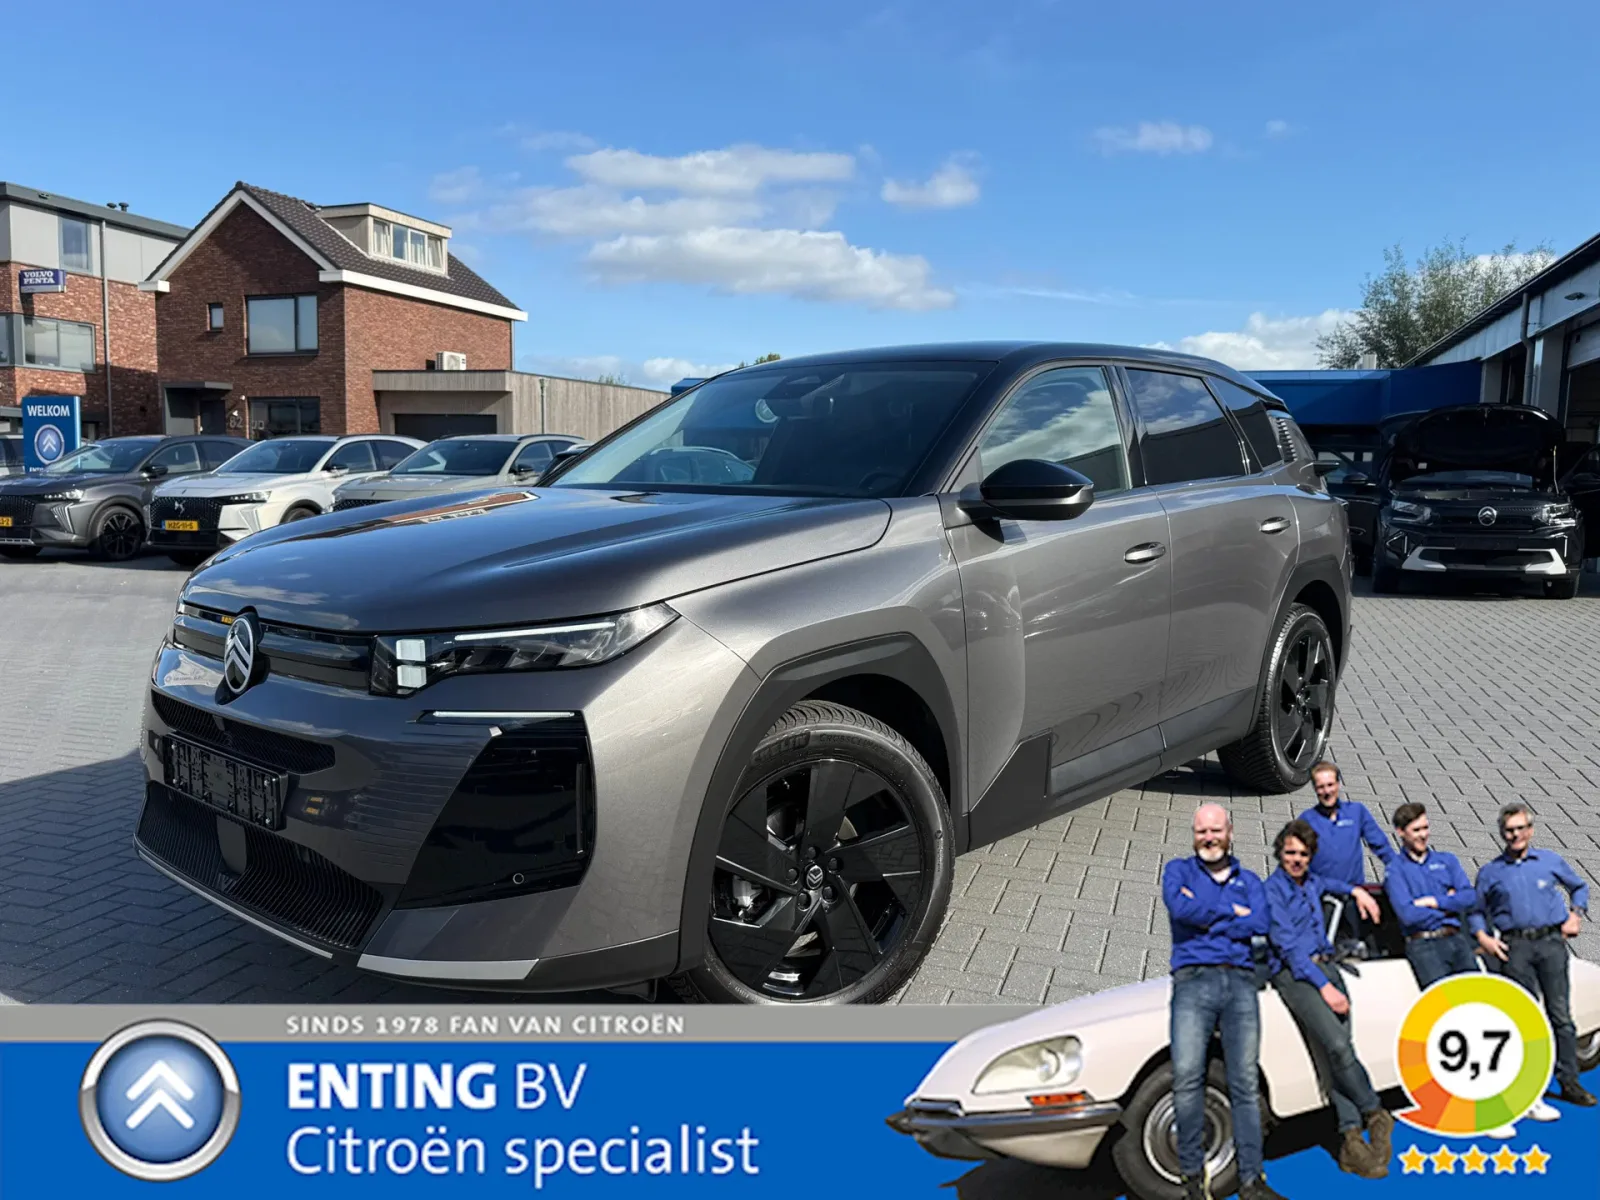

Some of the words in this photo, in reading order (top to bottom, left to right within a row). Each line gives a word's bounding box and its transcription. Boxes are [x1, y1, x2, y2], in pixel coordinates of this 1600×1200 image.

[23, 270, 54, 278] VOLVO
[23, 277, 56, 285] PENTA
[27, 404, 71, 417] WELKOM
